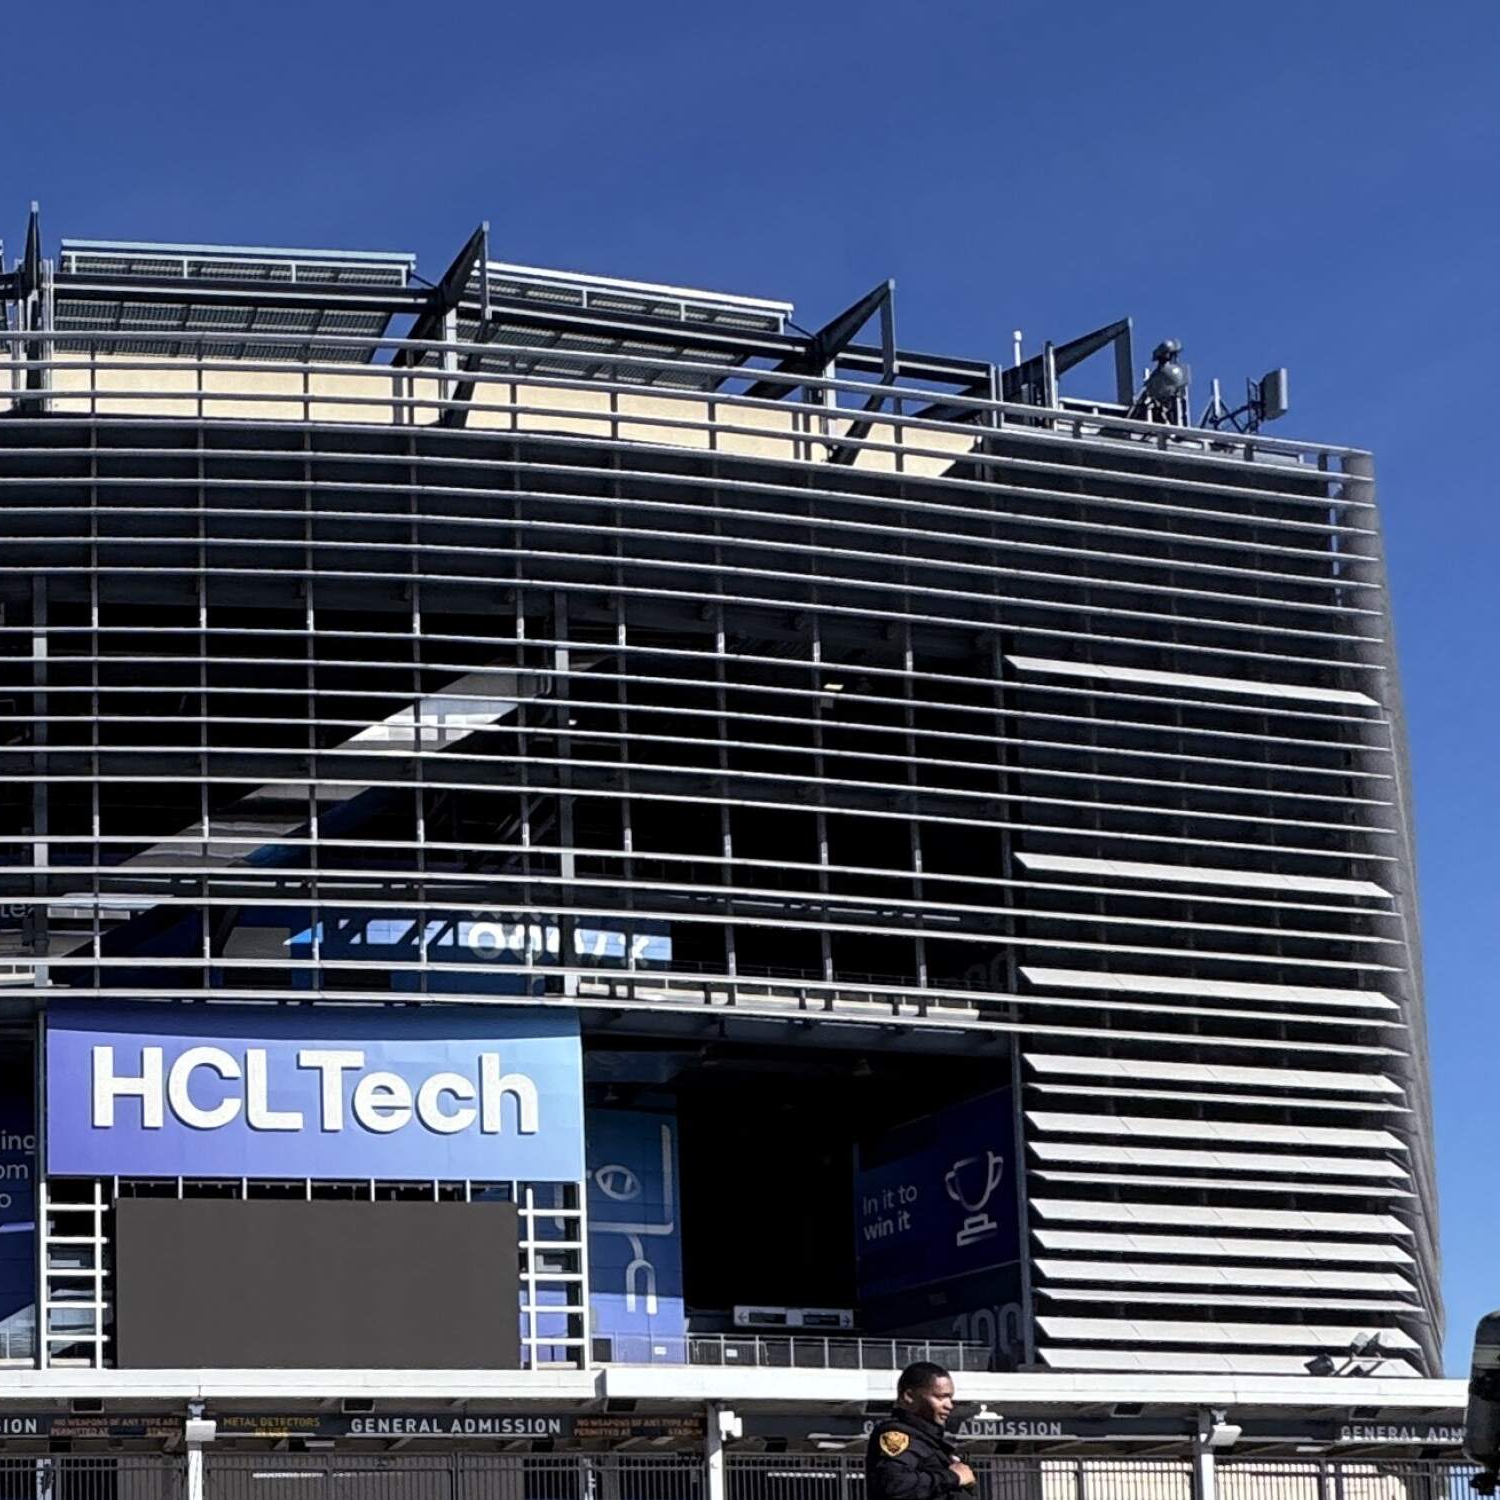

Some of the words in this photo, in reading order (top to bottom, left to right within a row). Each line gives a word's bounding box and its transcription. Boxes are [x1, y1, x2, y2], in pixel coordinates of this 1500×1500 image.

[92, 1046, 539, 1134] HCLTech
[863, 1196, 878, 1216] In
[882, 1189, 895, 1210] it
[898, 1185, 917, 1204] to
[863, 1216, 894, 1240] win
[897, 1210, 911, 1232] it
[350, 1418, 443, 1434] GENERAL
[451, 1418, 561, 1434] ADMISSION
[957, 1421, 1062, 1436] ADMISSION
[1341, 1425, 1421, 1441] GENERAL
